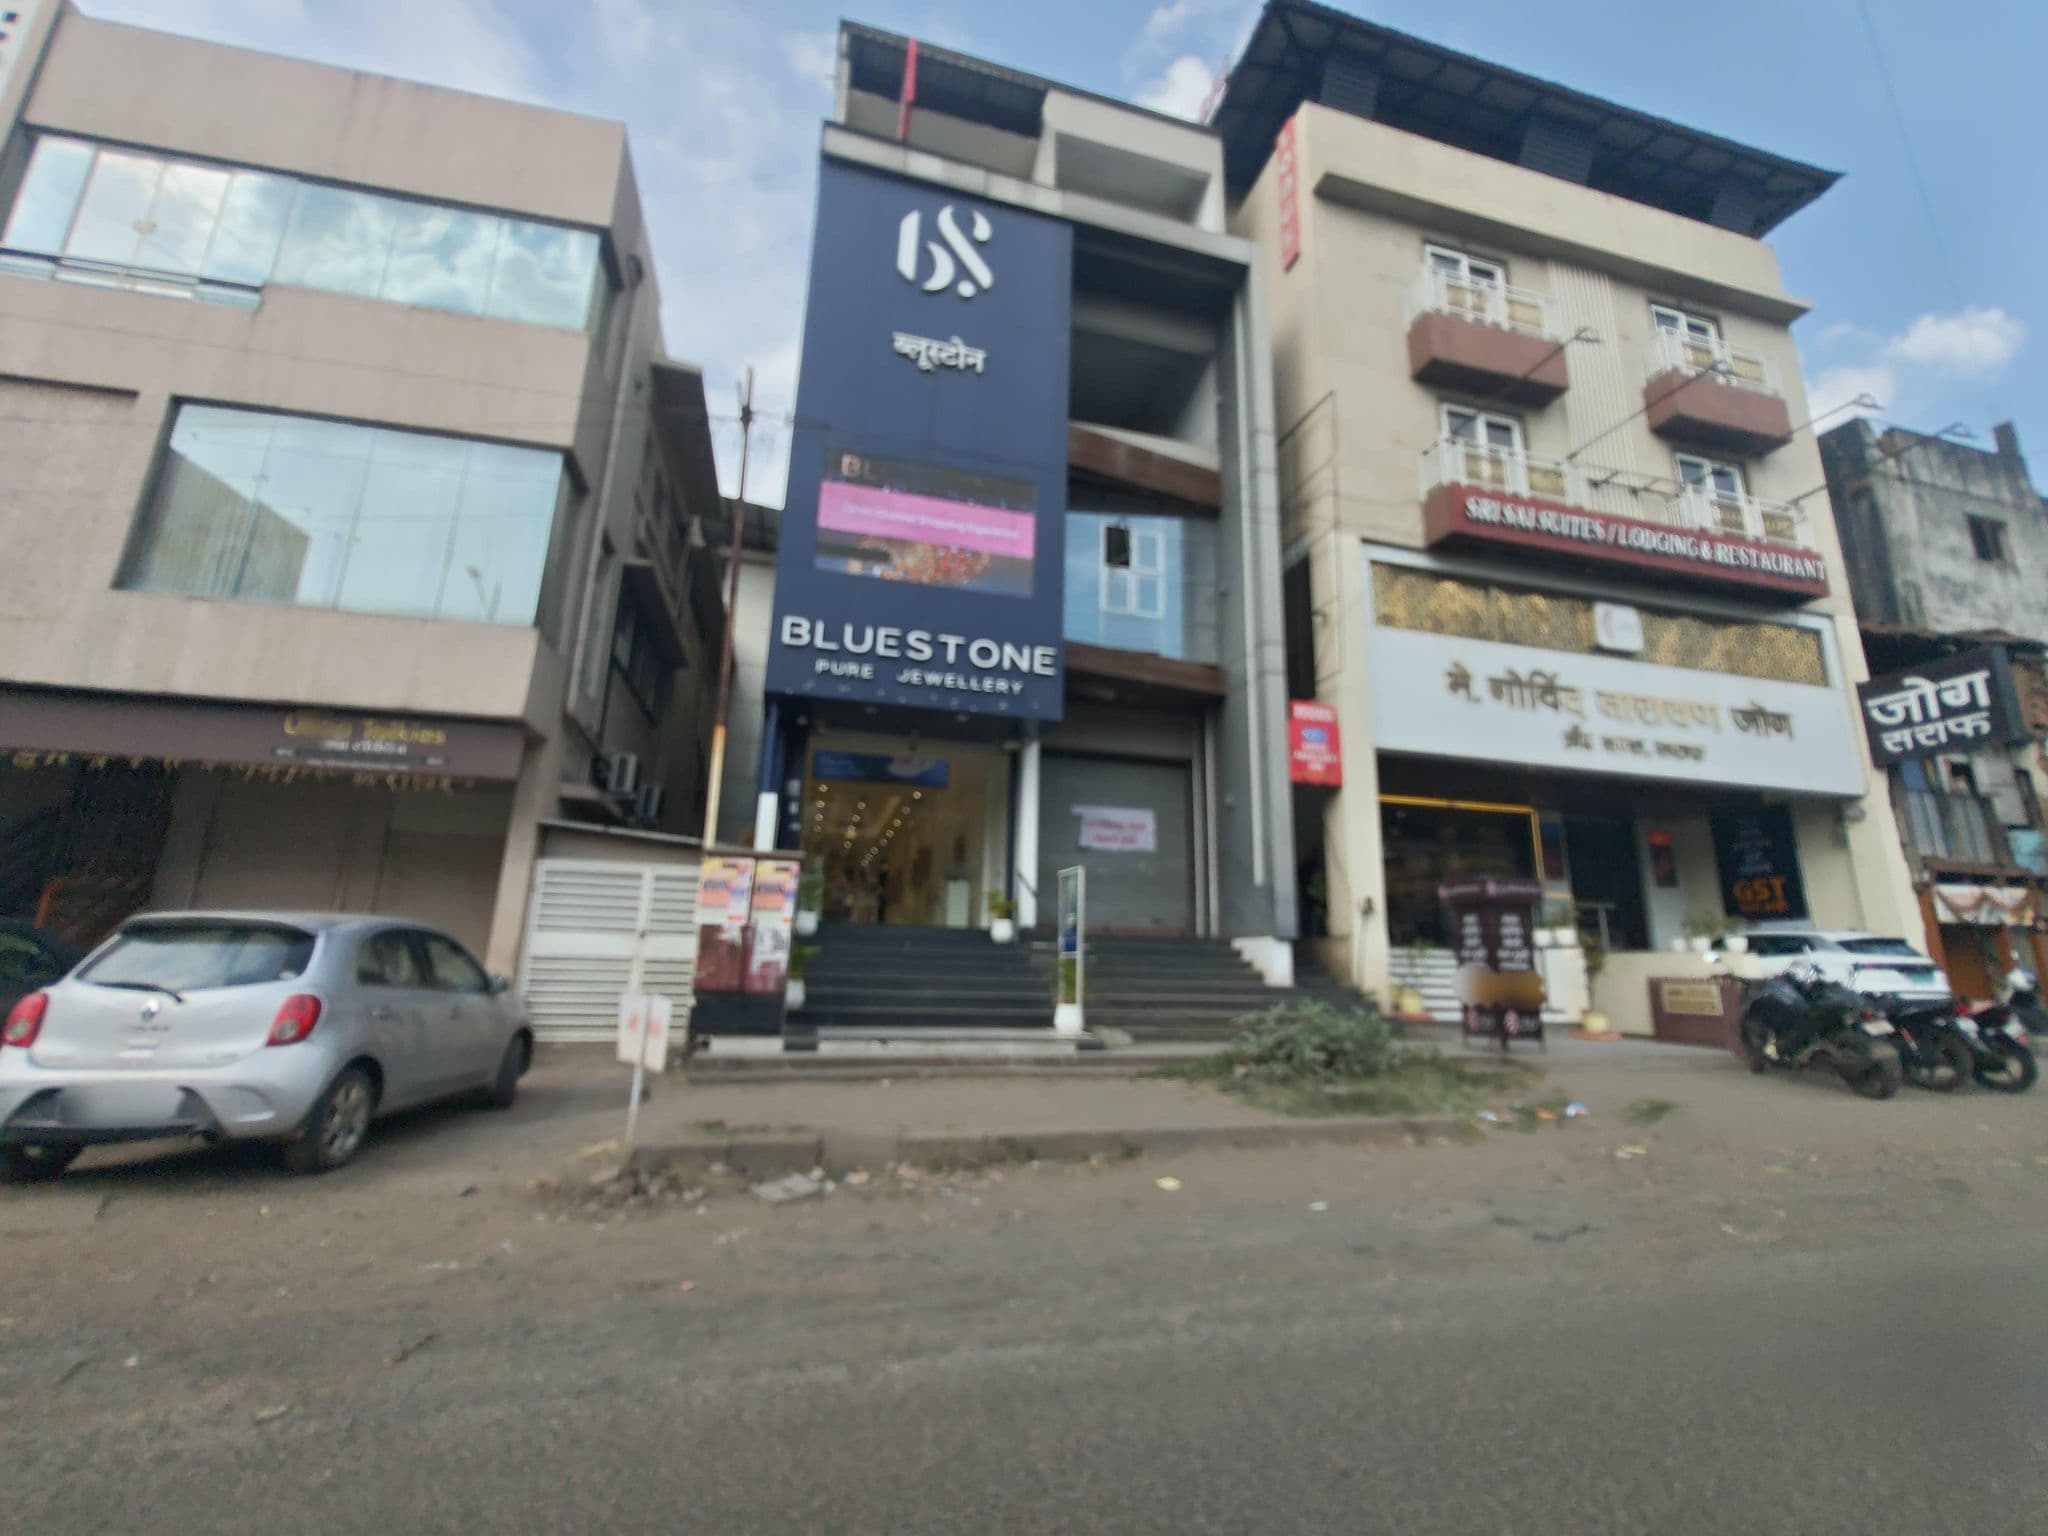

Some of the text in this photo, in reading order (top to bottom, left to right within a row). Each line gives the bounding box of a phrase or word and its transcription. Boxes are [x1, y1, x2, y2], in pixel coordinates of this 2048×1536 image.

[1716, 540, 1826, 582] RESTAURANT
[781, 614, 1057, 676] BLUESTONE
[814, 658, 1025, 696] PURE JEWELLERY
